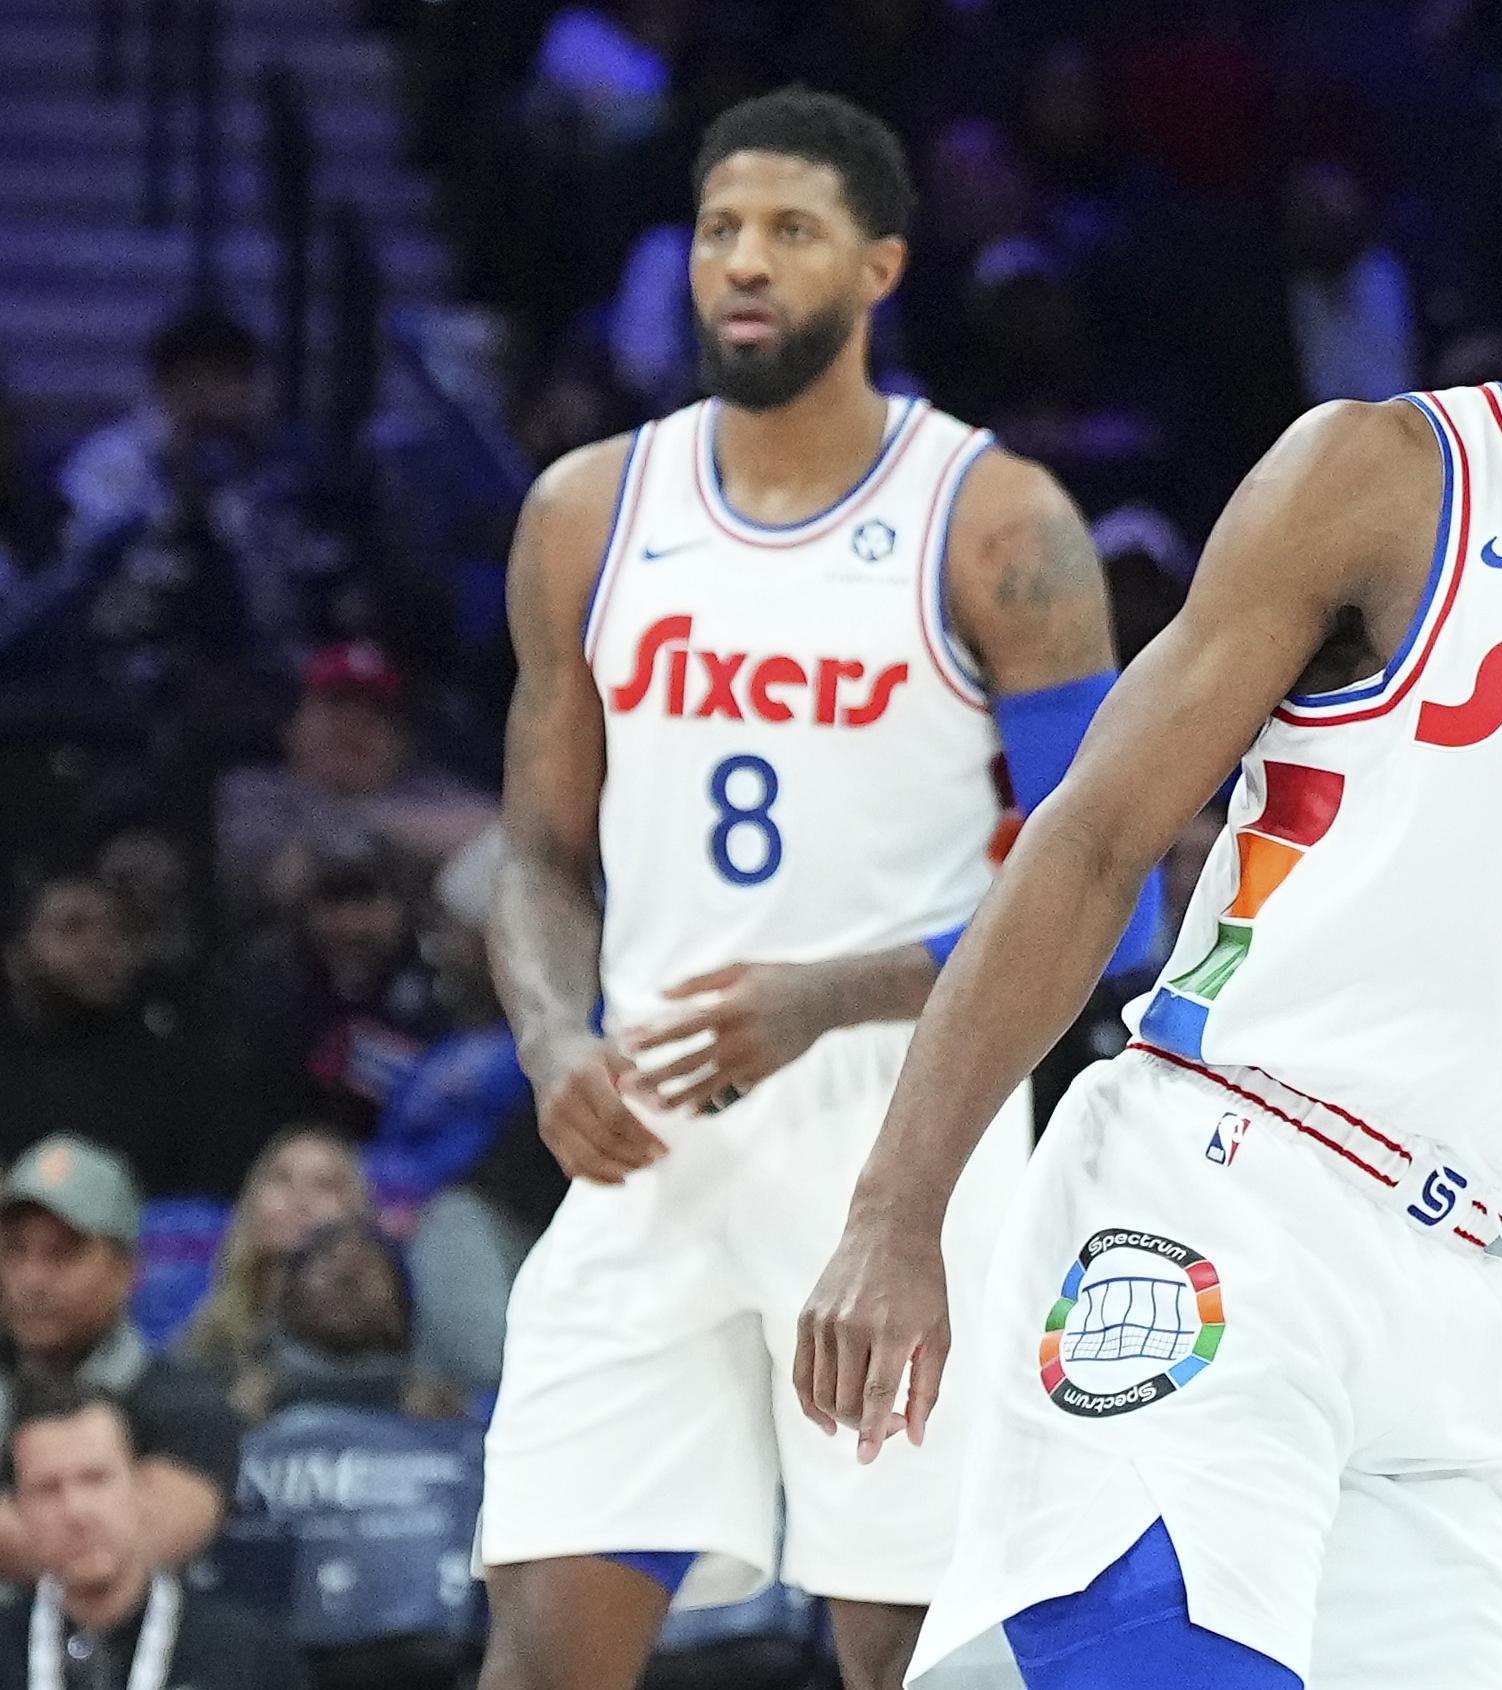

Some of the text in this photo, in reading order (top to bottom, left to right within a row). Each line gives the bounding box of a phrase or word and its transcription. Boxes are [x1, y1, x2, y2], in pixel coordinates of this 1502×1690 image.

[609, 615, 908, 728] Sixers
[711, 754, 782, 887] 8
[1087, 1232, 1188, 1261] Spectrum
[1063, 1381, 1158, 1413] Spectrum
